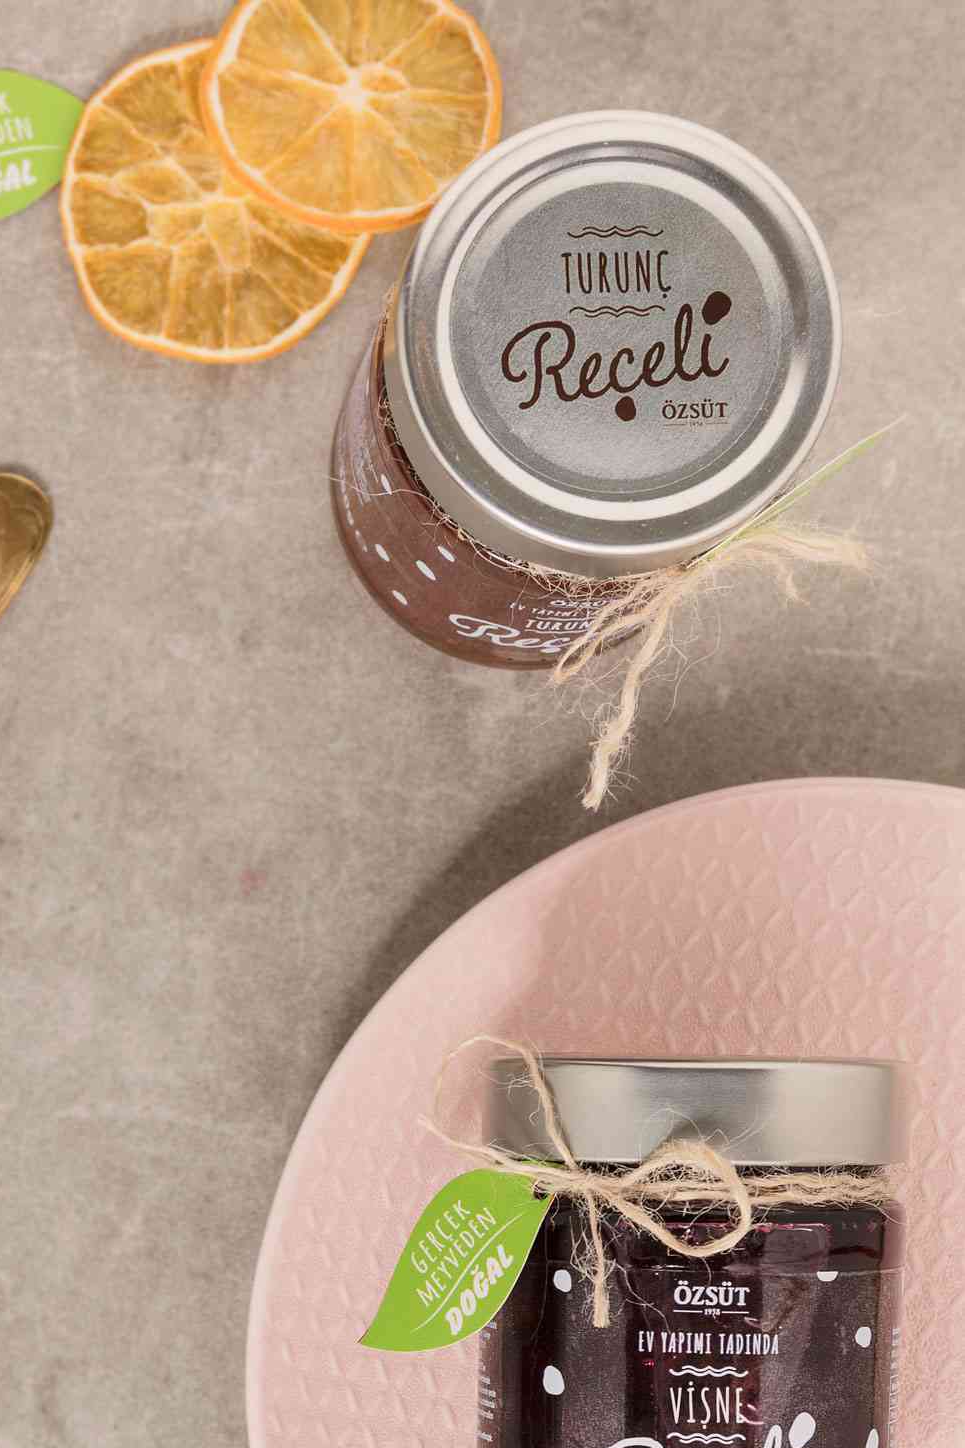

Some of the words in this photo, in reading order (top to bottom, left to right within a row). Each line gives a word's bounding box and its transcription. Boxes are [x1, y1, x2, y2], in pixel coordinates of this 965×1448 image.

[561, 250, 672, 299] TURUNÇ
[501, 291, 732, 421] Reçeli
[662, 399, 728, 419] ÖZSÜT
[449, 614, 572, 653] Reç
[525, 619, 595, 632] TURUN
[416, 1207, 497, 1308] MEYVEDEN
[445, 1244, 514, 1336] DOĞAL
[673, 1280, 750, 1306] ÖZSÜT
[638, 1331, 655, 1353] EV
[661, 1331, 712, 1355] YAPIMI
[719, 1333, 779, 1356] TADINDA
[669, 1381, 746, 1430] VİŞNE
